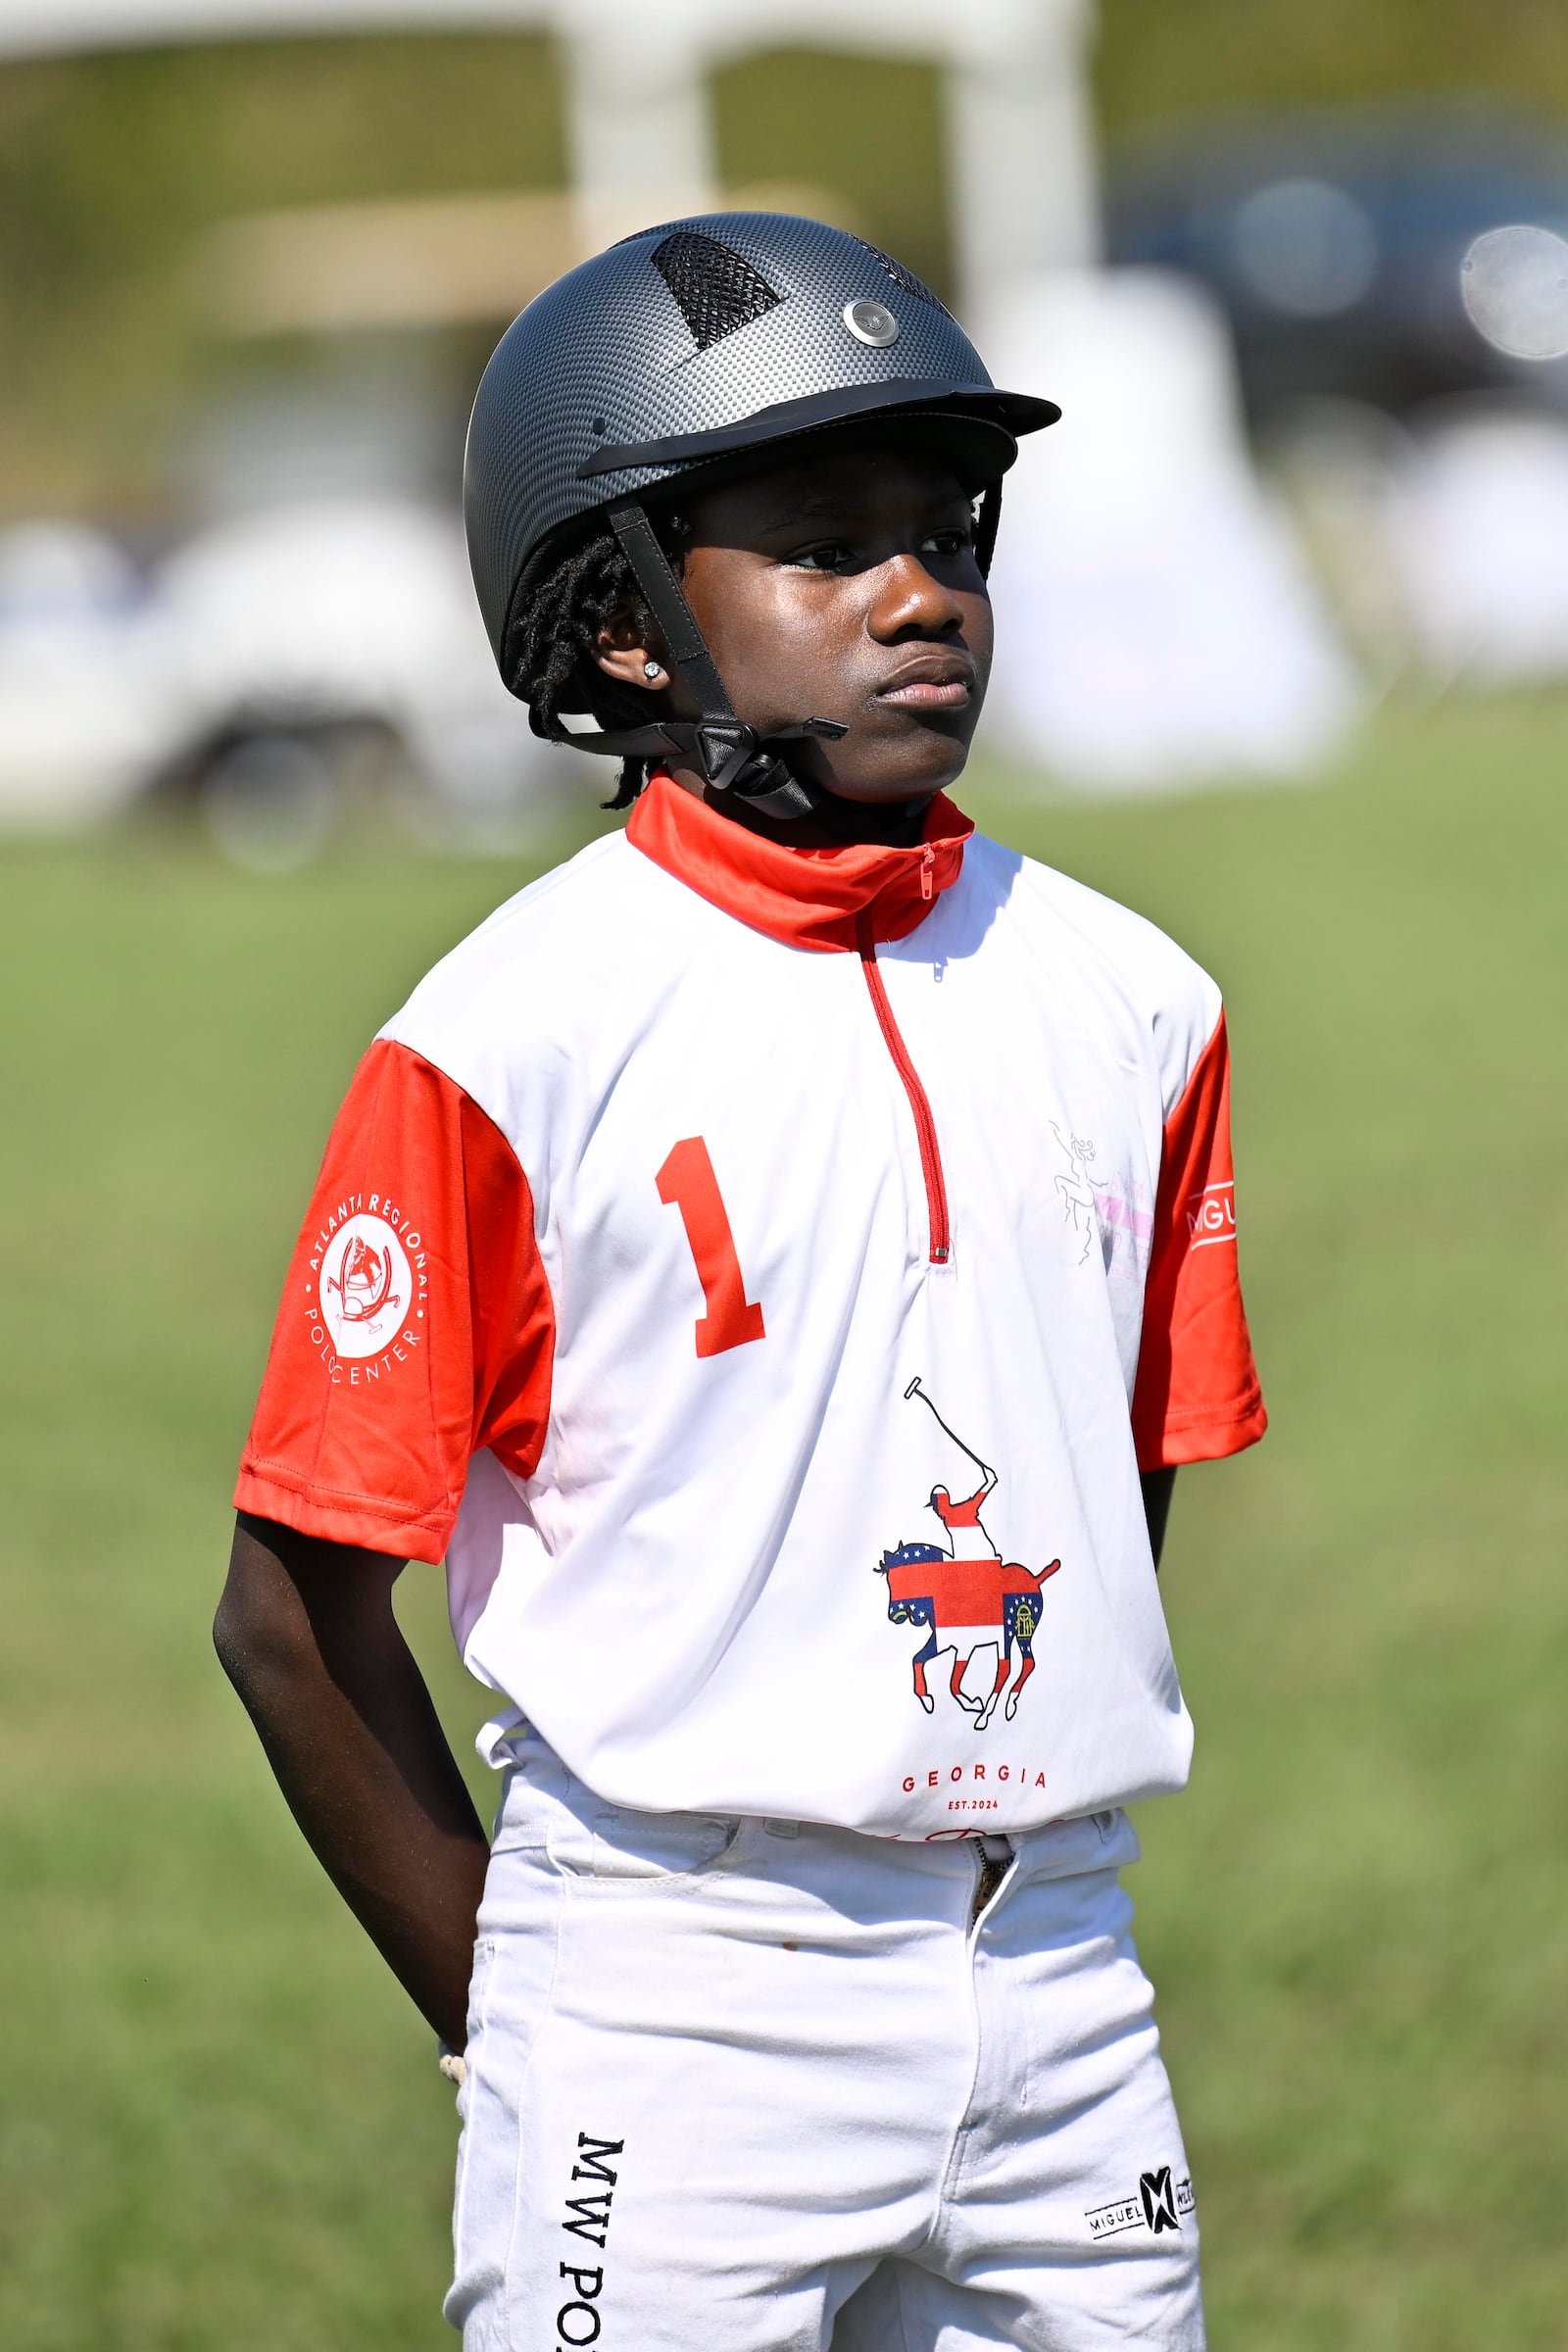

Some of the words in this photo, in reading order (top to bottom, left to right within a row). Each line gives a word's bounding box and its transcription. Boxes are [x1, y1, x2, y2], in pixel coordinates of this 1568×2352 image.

[310, 1193, 362, 1271] ATLANTA
[368, 1193, 428, 1300] REGIONAL
[655, 1136, 765, 1357] 1
[331, 1330, 420, 1385] CENTER
[903, 1764, 1046, 1792] GEORGIA
[948, 1799, 999, 1810] EST.2024
[562, 2132, 624, 2249] MW
[1090, 2206, 1144, 2231] MIGUEL
[557, 2261, 604, 2352] PO
